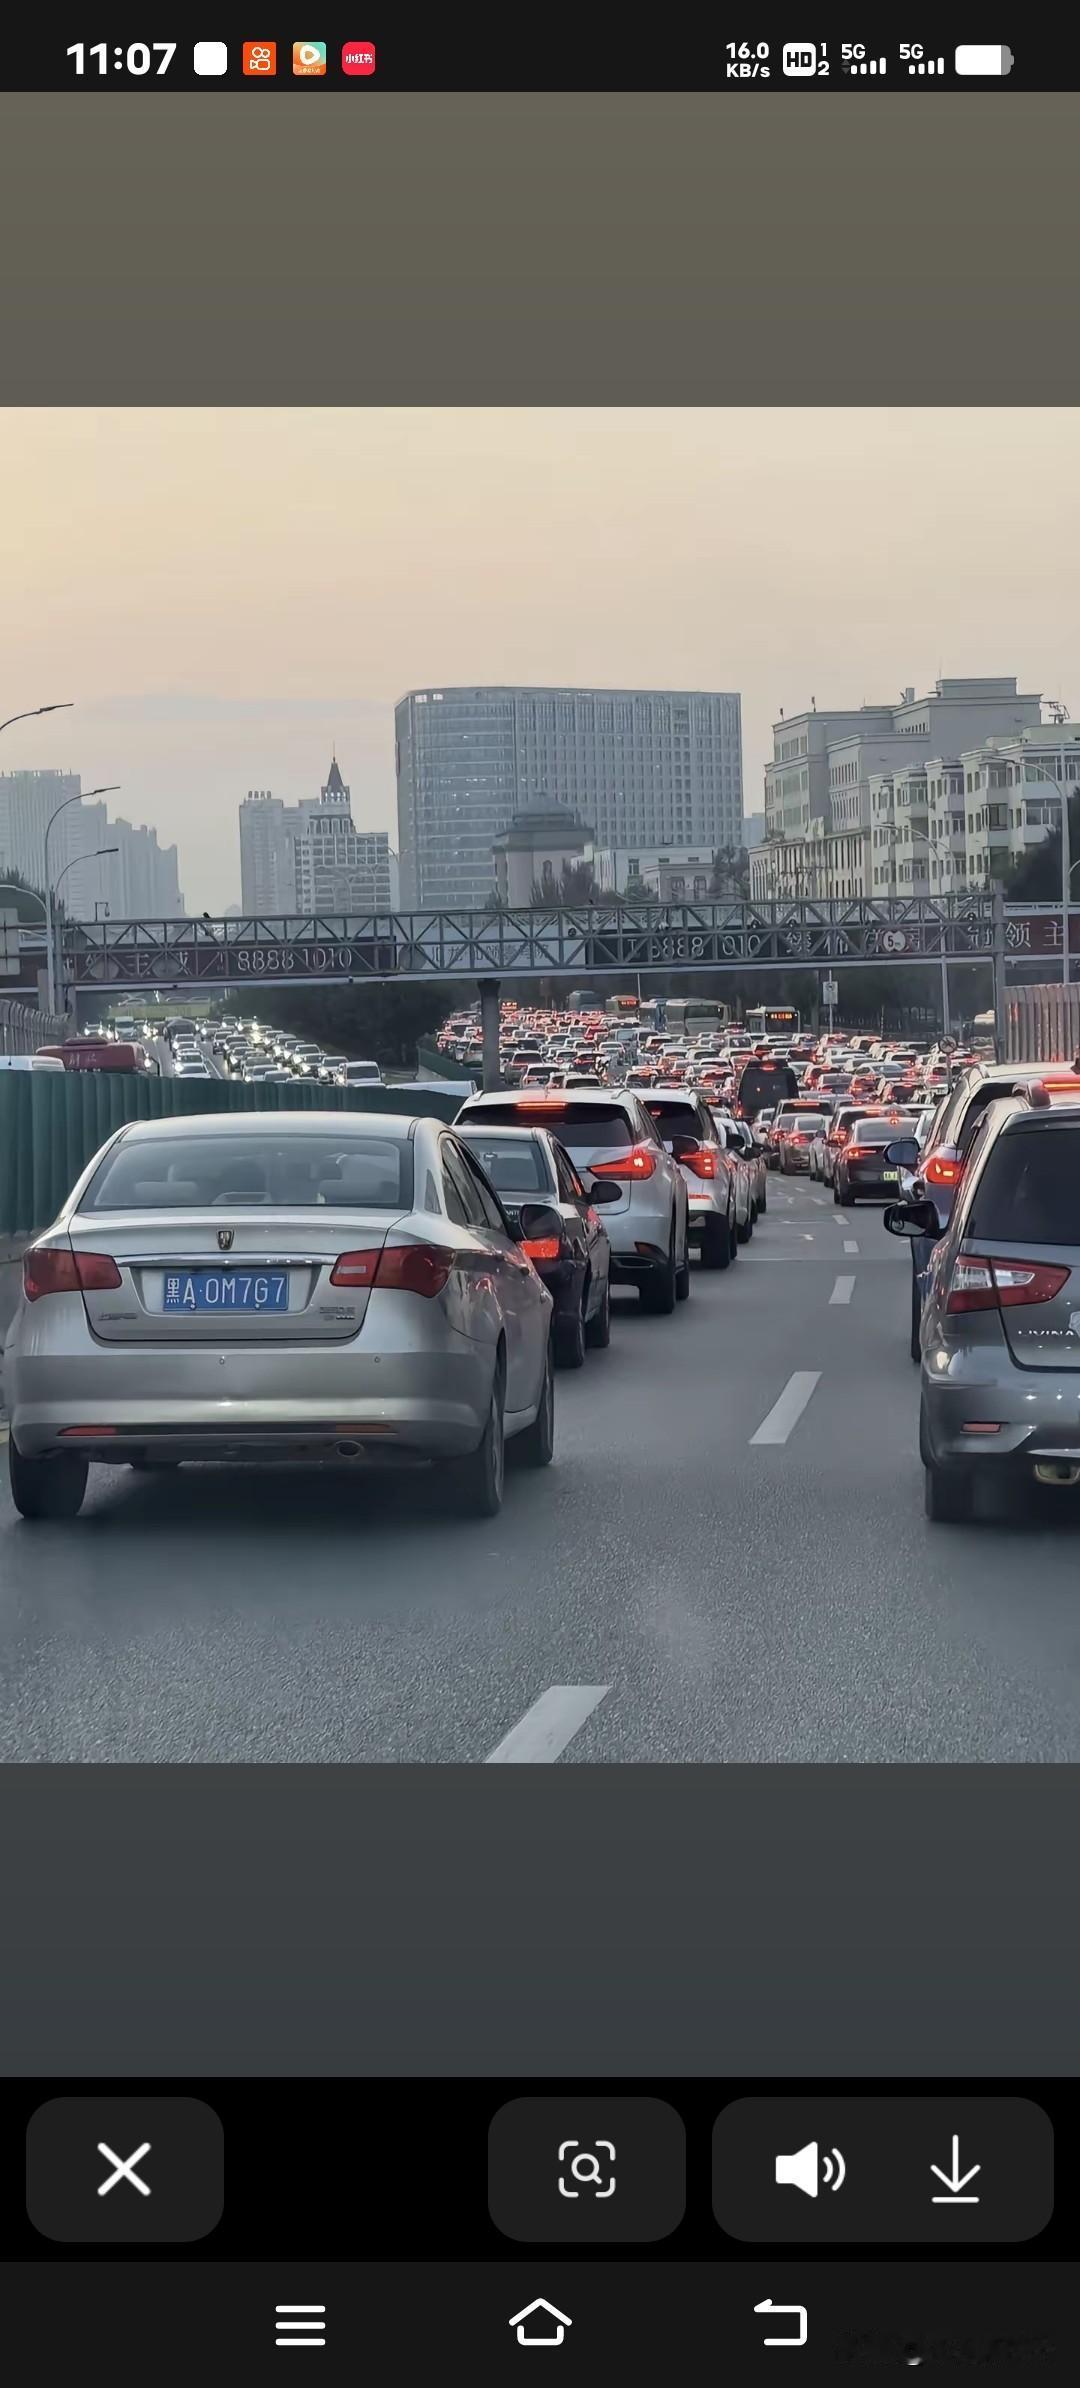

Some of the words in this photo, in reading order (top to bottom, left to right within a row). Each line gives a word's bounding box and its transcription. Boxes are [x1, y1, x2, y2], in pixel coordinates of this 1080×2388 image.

[726, 42, 769, 59] 16.0
[841, 43, 866, 60] 5G
[899, 43, 924, 60] 5G
[67, 43, 177, 76] 11:07
[786, 51, 812, 68] HD
[726, 62, 771, 78] KB/s
